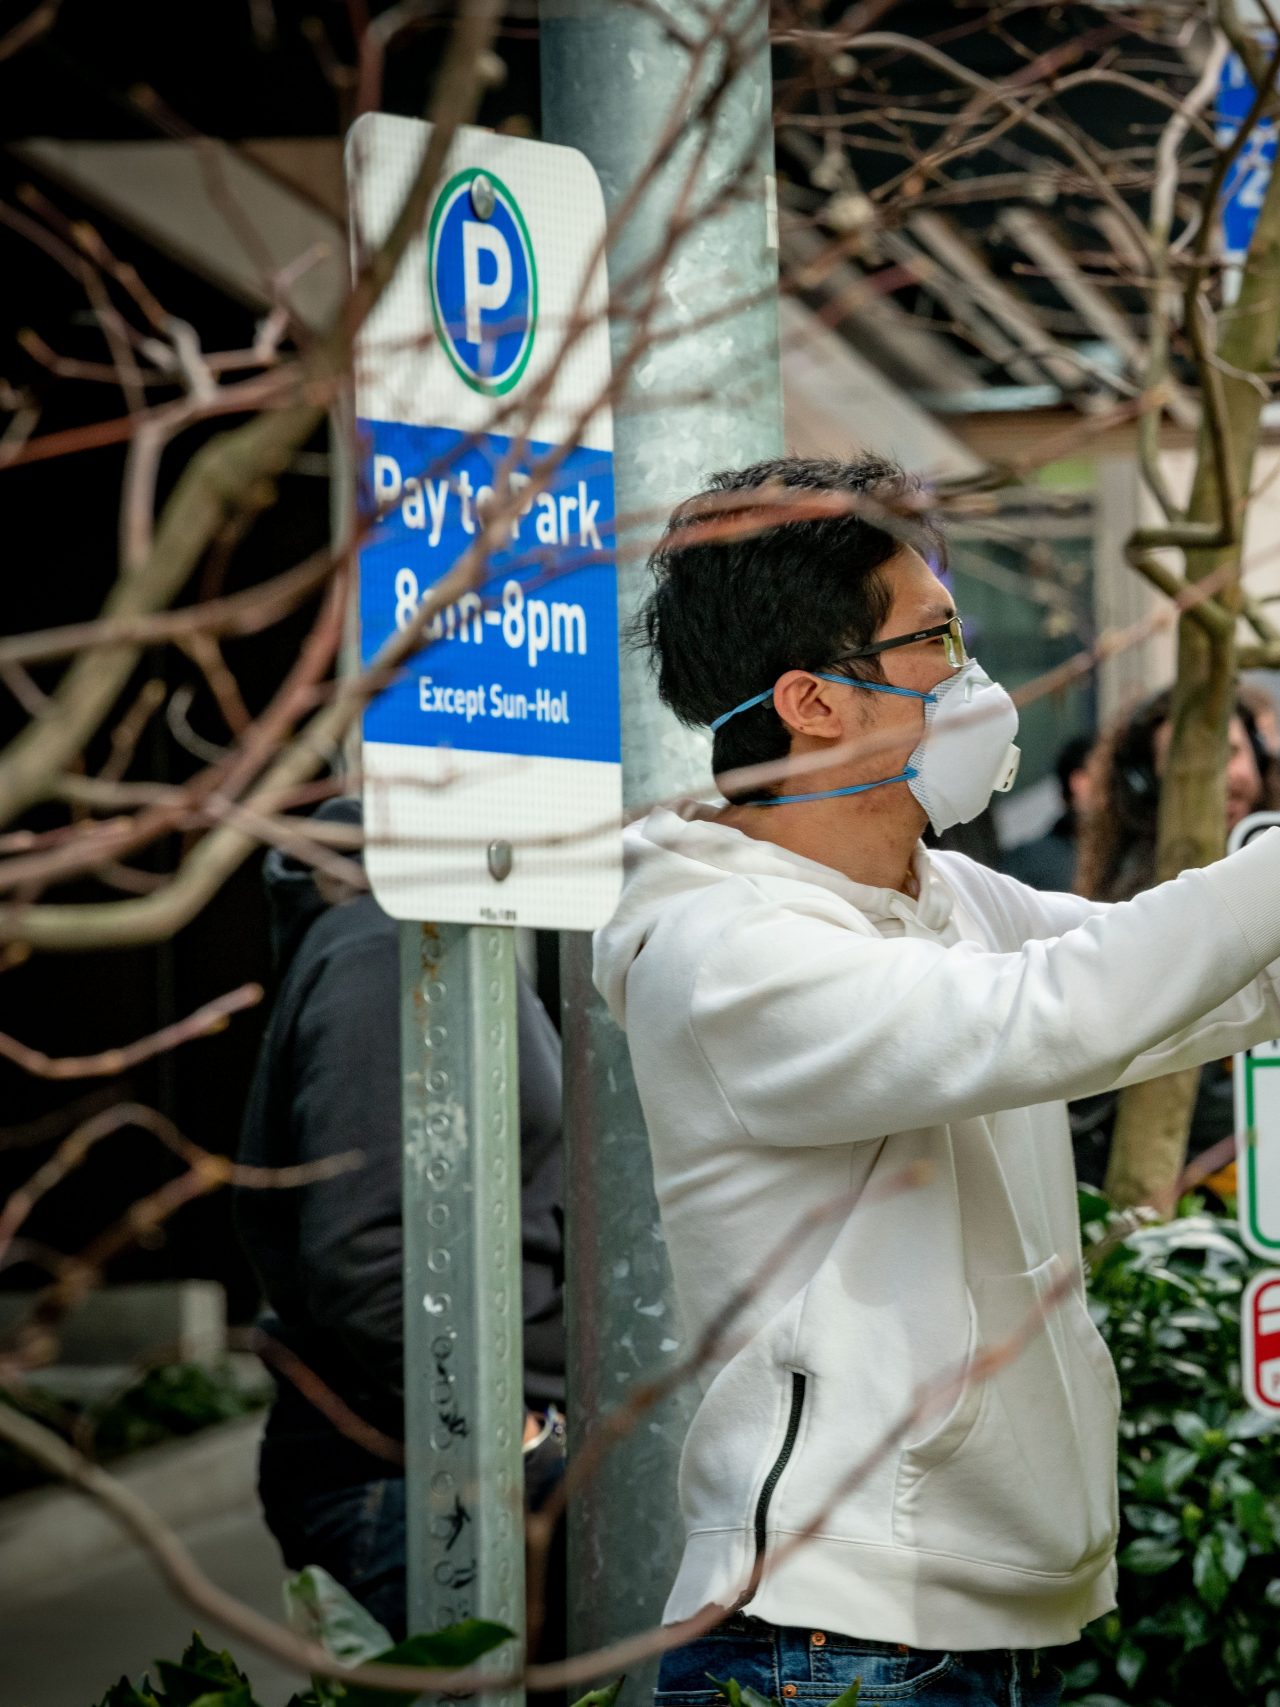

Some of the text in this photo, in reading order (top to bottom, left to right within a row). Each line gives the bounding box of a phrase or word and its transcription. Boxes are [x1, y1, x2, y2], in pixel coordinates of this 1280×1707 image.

[463, 221, 512, 344] P
[374, 455, 449, 547] Pay
[509, 472, 602, 550] Park
[395, 567, 587, 668] 8am-8pm
[419, 676, 570, 724] Except Sun-Hol
